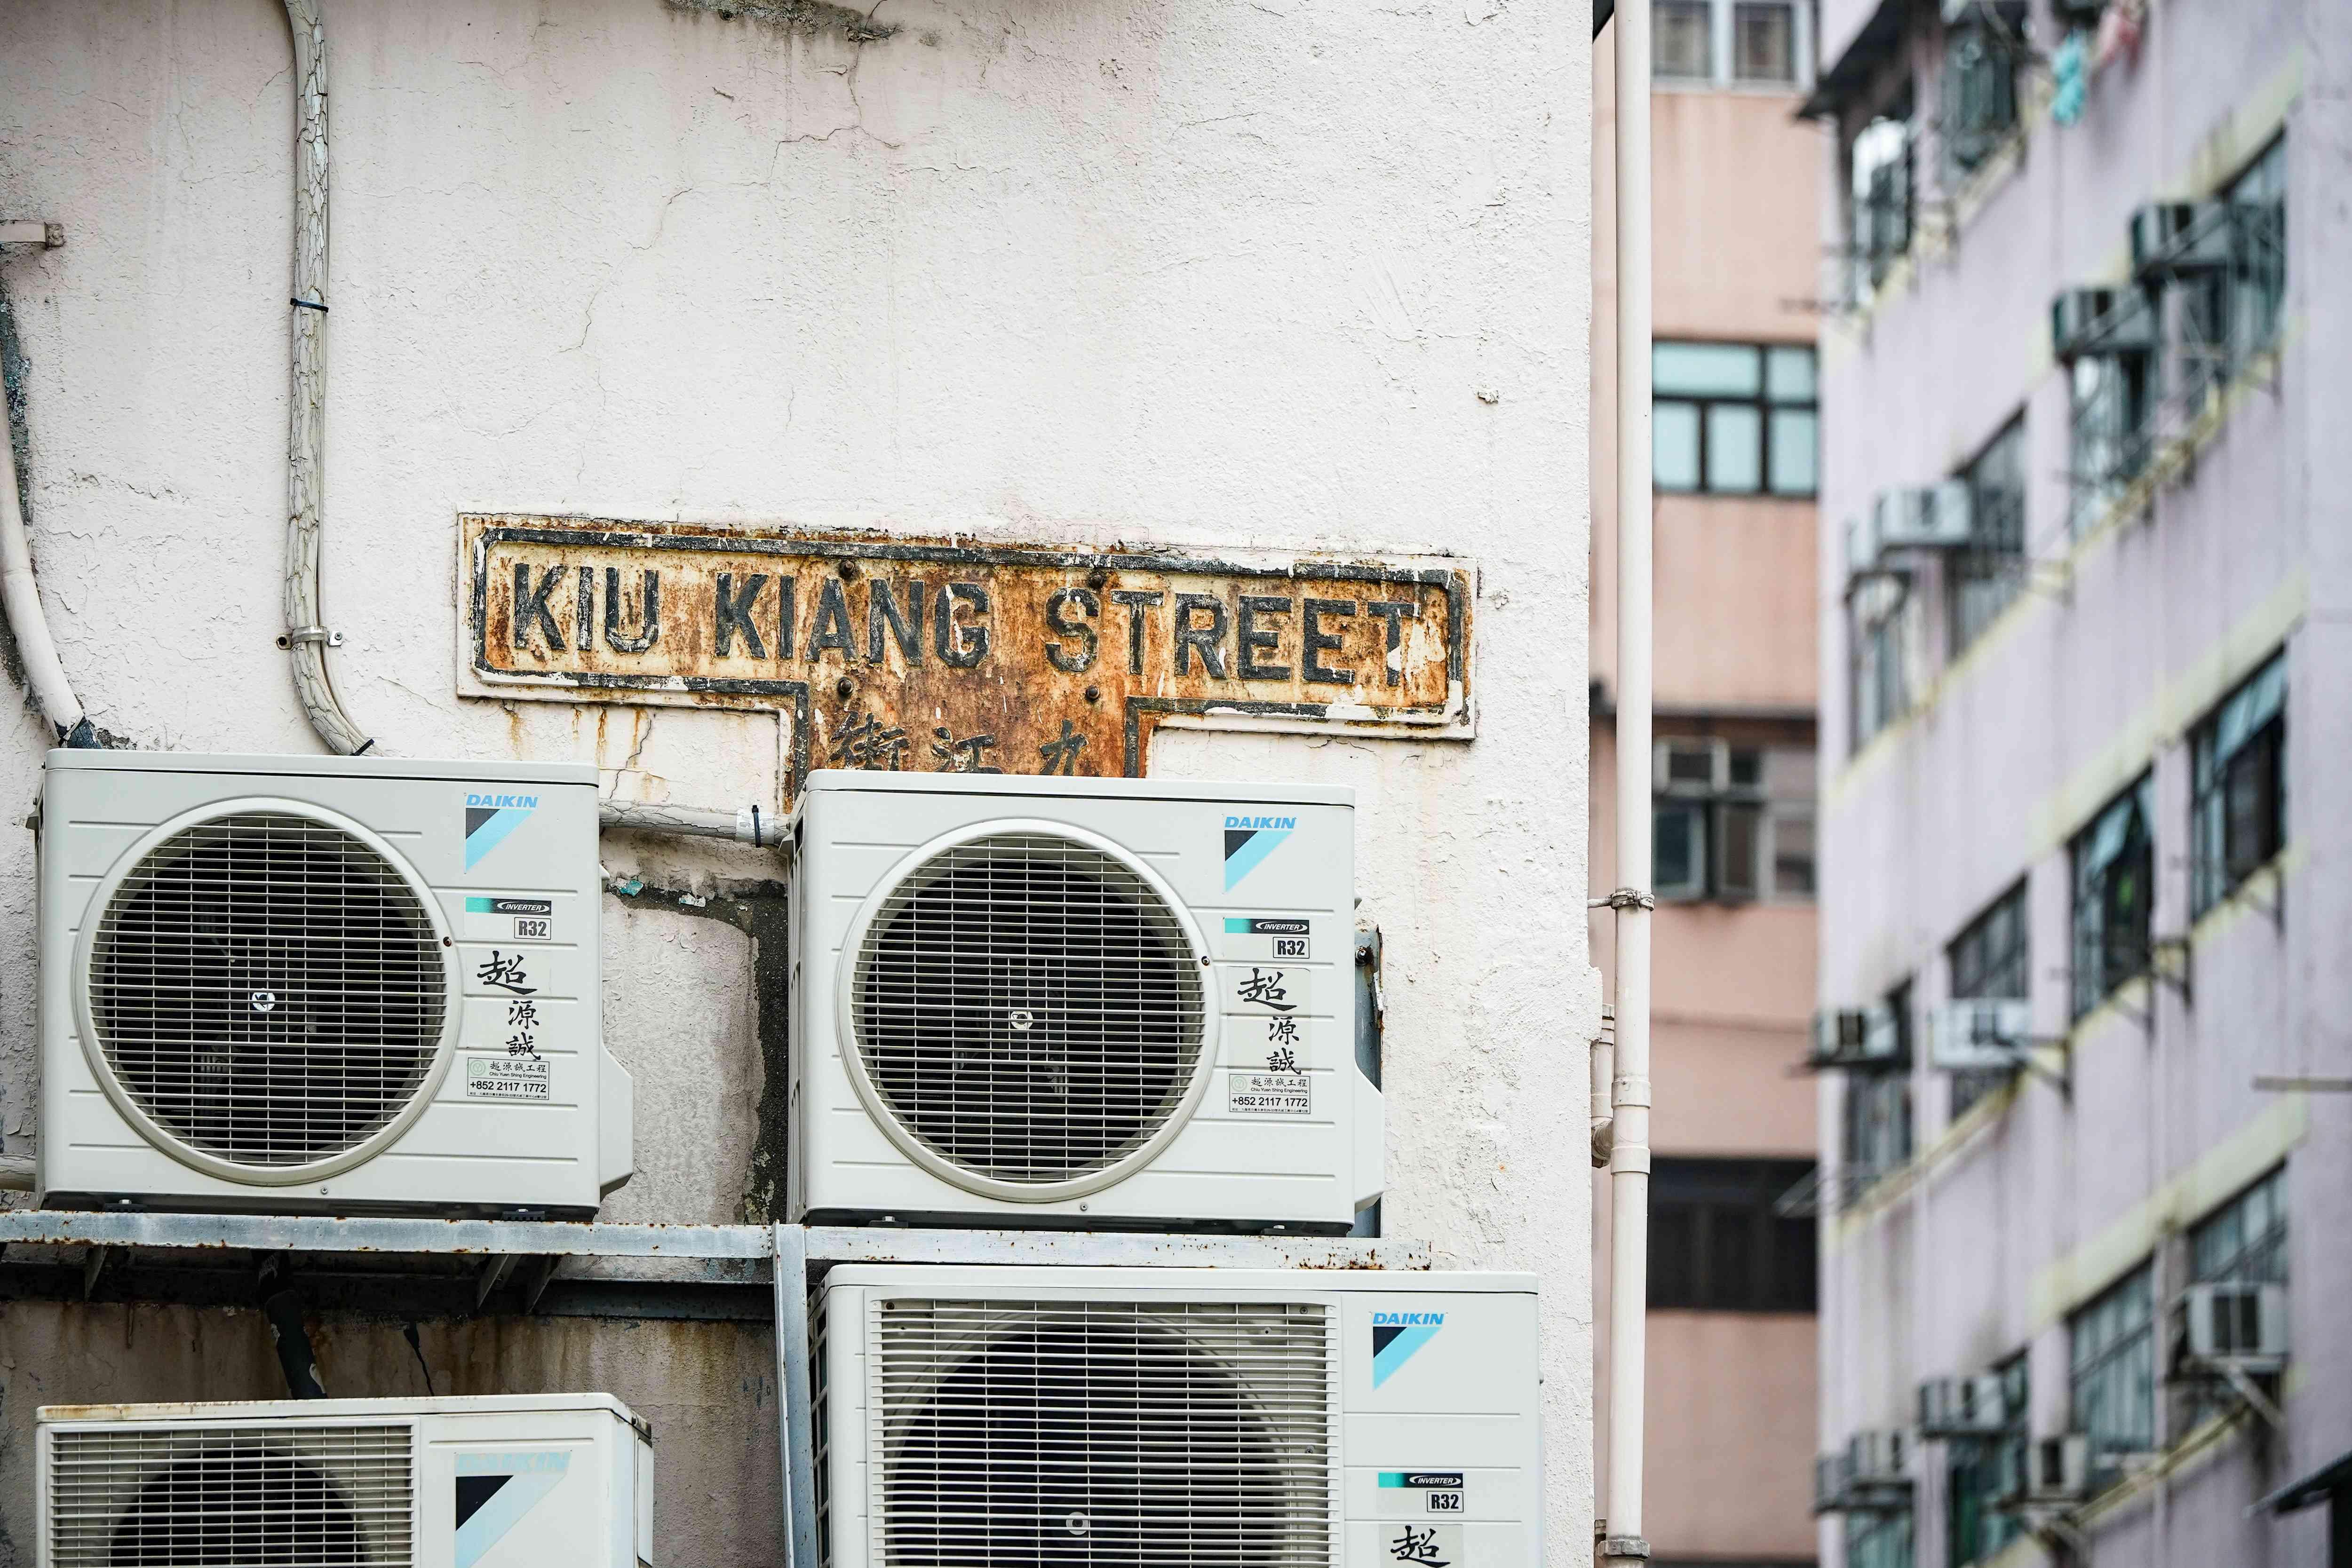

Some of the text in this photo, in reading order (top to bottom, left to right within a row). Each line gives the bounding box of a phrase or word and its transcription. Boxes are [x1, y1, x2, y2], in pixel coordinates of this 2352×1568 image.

[514, 563, 1420, 687] KIU KIANG STREET
[466, 794, 538, 808] DAIKIN
[1224, 816, 1296, 829] DAIKIN
[505, 903, 542, 912] INVERTER
[518, 920, 546, 936] R32
[1277, 940, 1305, 956] R32
[470, 1081, 546, 1093] +852 2117 1772
[1232, 1096, 1308, 1107] +852 2117 1772
[1373, 1313, 1445, 1325] DAIKIN
[1431, 1494, 1459, 1509] R32
